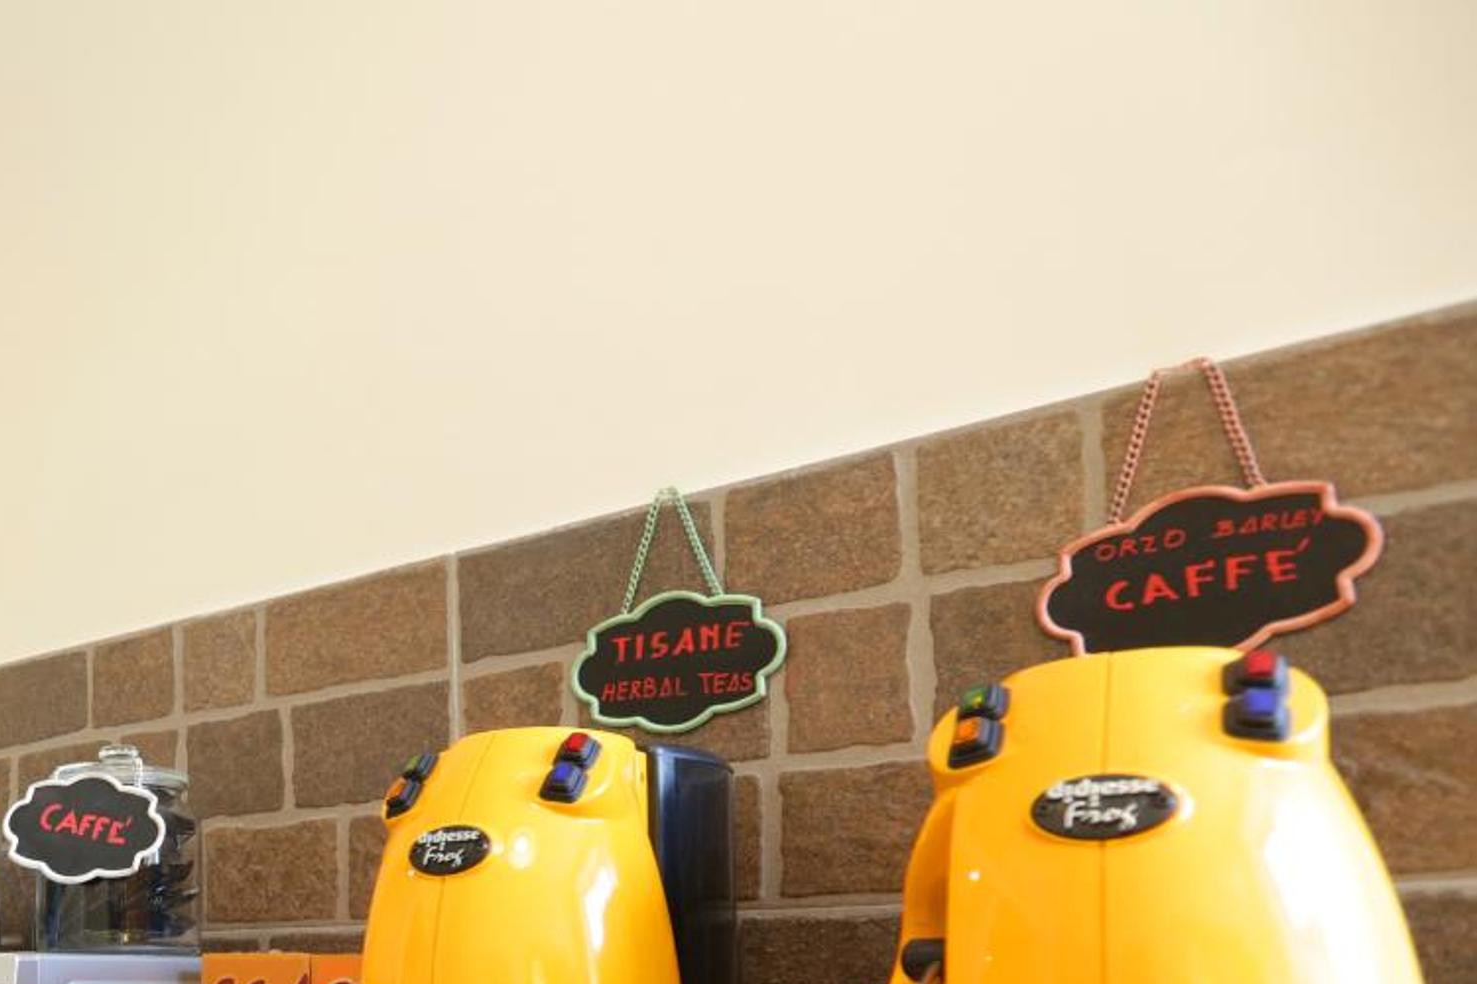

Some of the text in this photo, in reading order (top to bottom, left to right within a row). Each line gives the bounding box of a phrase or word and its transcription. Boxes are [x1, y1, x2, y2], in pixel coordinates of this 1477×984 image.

[1095, 507, 1325, 562] ORZO BARLEY
[611, 620, 752, 663] TISANE
[601, 671, 753, 701] HERBAL TEAS
